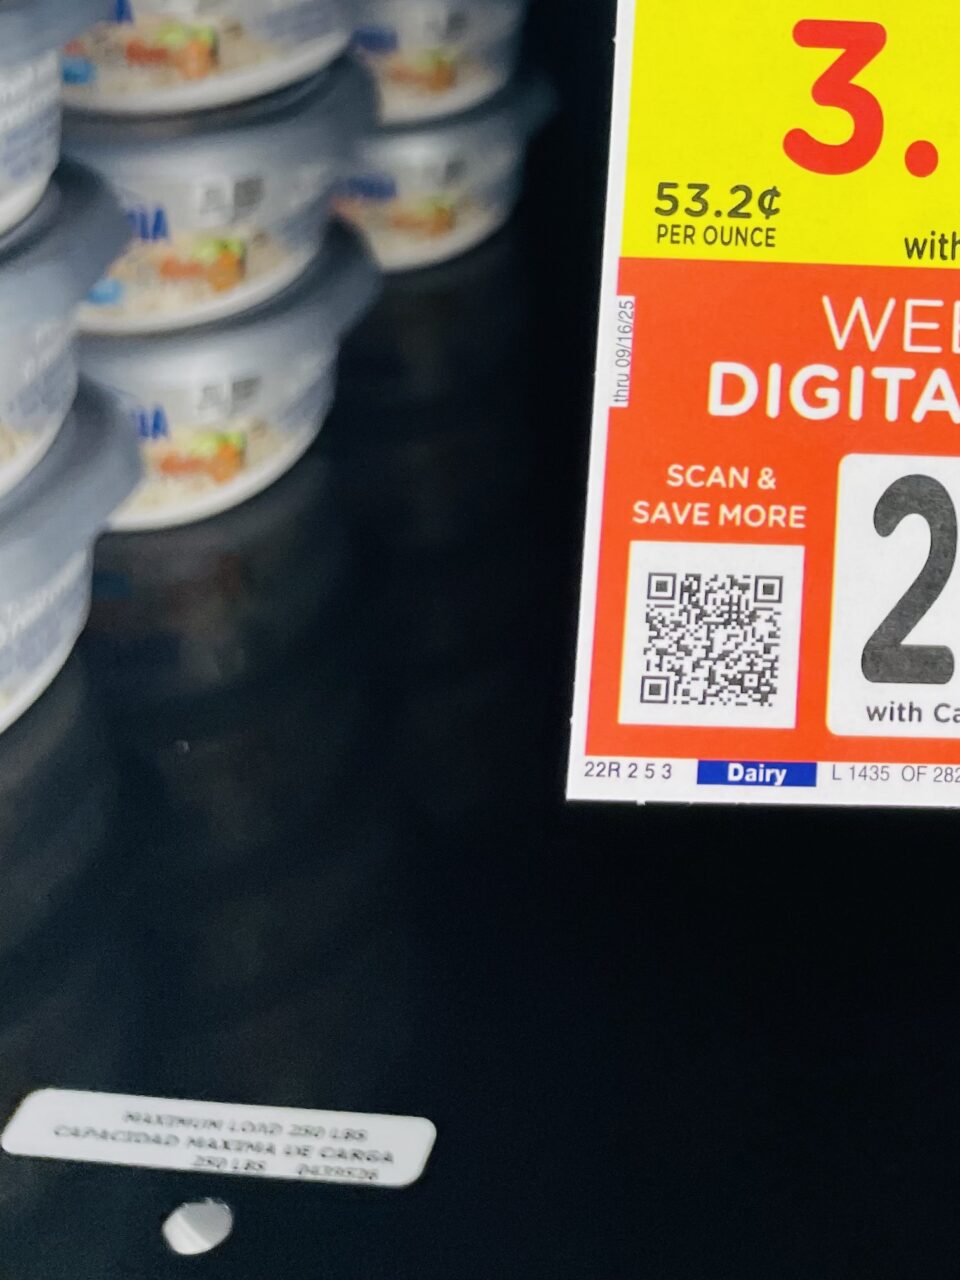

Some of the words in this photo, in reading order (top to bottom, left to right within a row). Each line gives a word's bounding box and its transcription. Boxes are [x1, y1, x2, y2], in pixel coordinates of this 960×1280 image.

[653, 182, 782, 220] 53.2¢
[655, 223, 697, 246] PER
[702, 225, 777, 249] OUNCE
[615, 300, 635, 368] 09/16/25
[613, 373, 630, 403] thru
[666, 463, 751, 489] SCAN
[758, 466, 777, 491] &
[632, 500, 712, 526] SAVE
[718, 503, 808, 529] MORE
[866, 701, 925, 725] with
[584, 761, 621, 779] 22R
[727, 763, 788, 786] Dairy
[831, 765, 842, 782] L
[848, 765, 890, 783] 1435
[900, 766, 928, 783] OF
